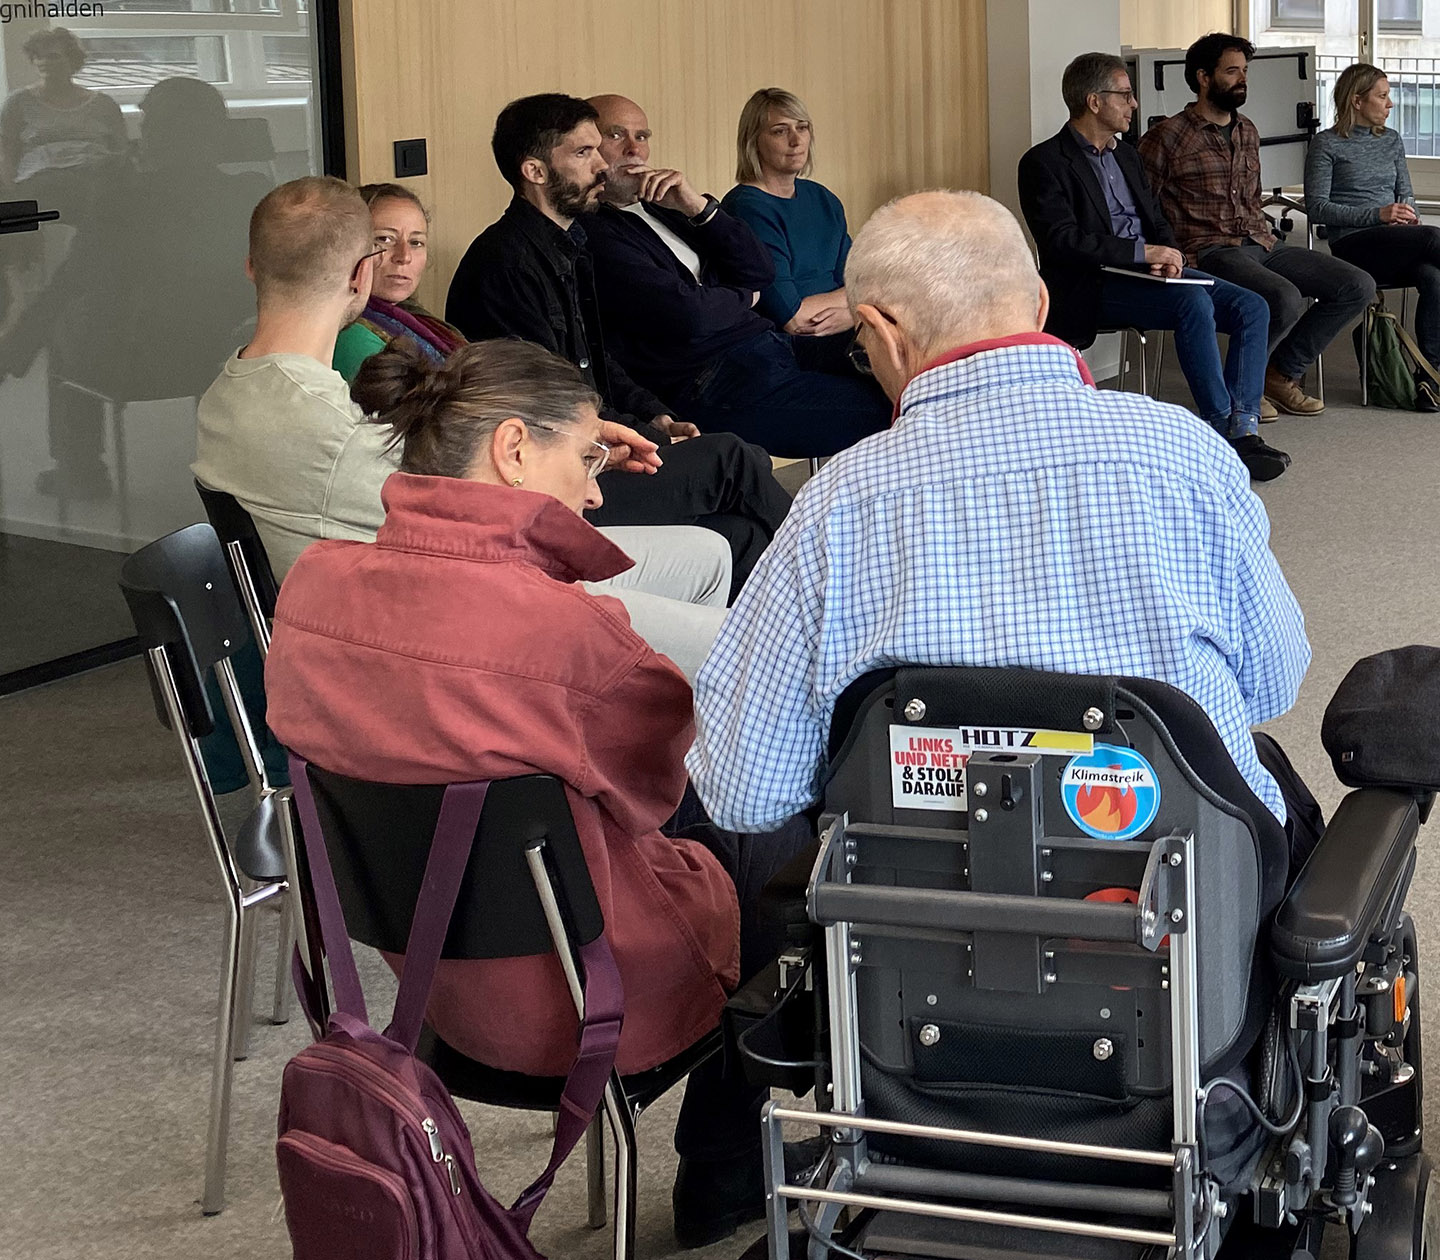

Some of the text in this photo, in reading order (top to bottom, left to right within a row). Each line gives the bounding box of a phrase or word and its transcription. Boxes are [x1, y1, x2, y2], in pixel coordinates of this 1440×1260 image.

[0, 0, 104, 23] gnihalden
[908, 737, 953, 753] LINKS
[962, 728, 1038, 748] HOTZ
[894, 751, 969, 769] UND NETT
[902, 765, 964, 783] & STOLZ
[1071, 769, 1144, 784] Klimastreik
[902, 780, 965, 798] DARAUF
